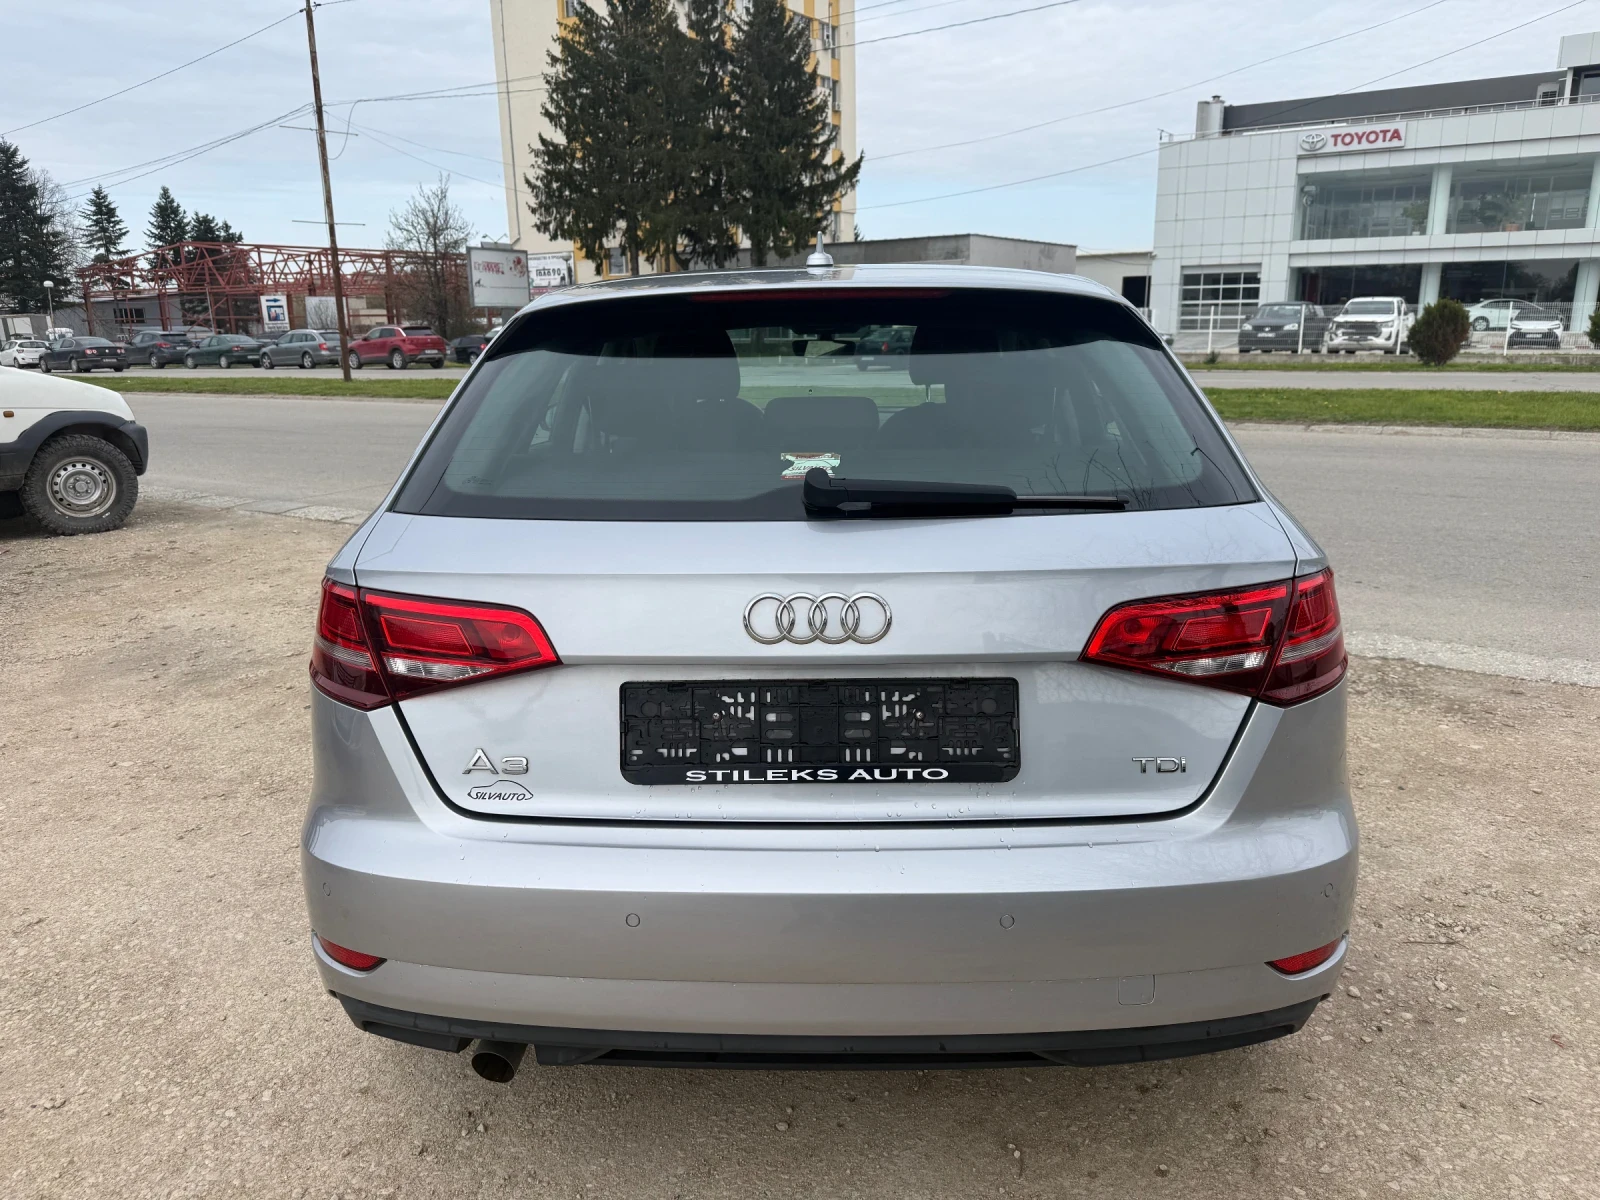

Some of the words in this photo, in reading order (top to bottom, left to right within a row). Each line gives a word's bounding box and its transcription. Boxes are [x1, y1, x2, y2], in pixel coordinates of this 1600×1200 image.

[1331, 128, 1402, 147] TOYOTA
[462, 747, 529, 775] A3
[685, 768, 839, 782] STILEKS
[848, 768, 949, 780] AUTO
[474, 791, 526, 801] SILVAUTO
